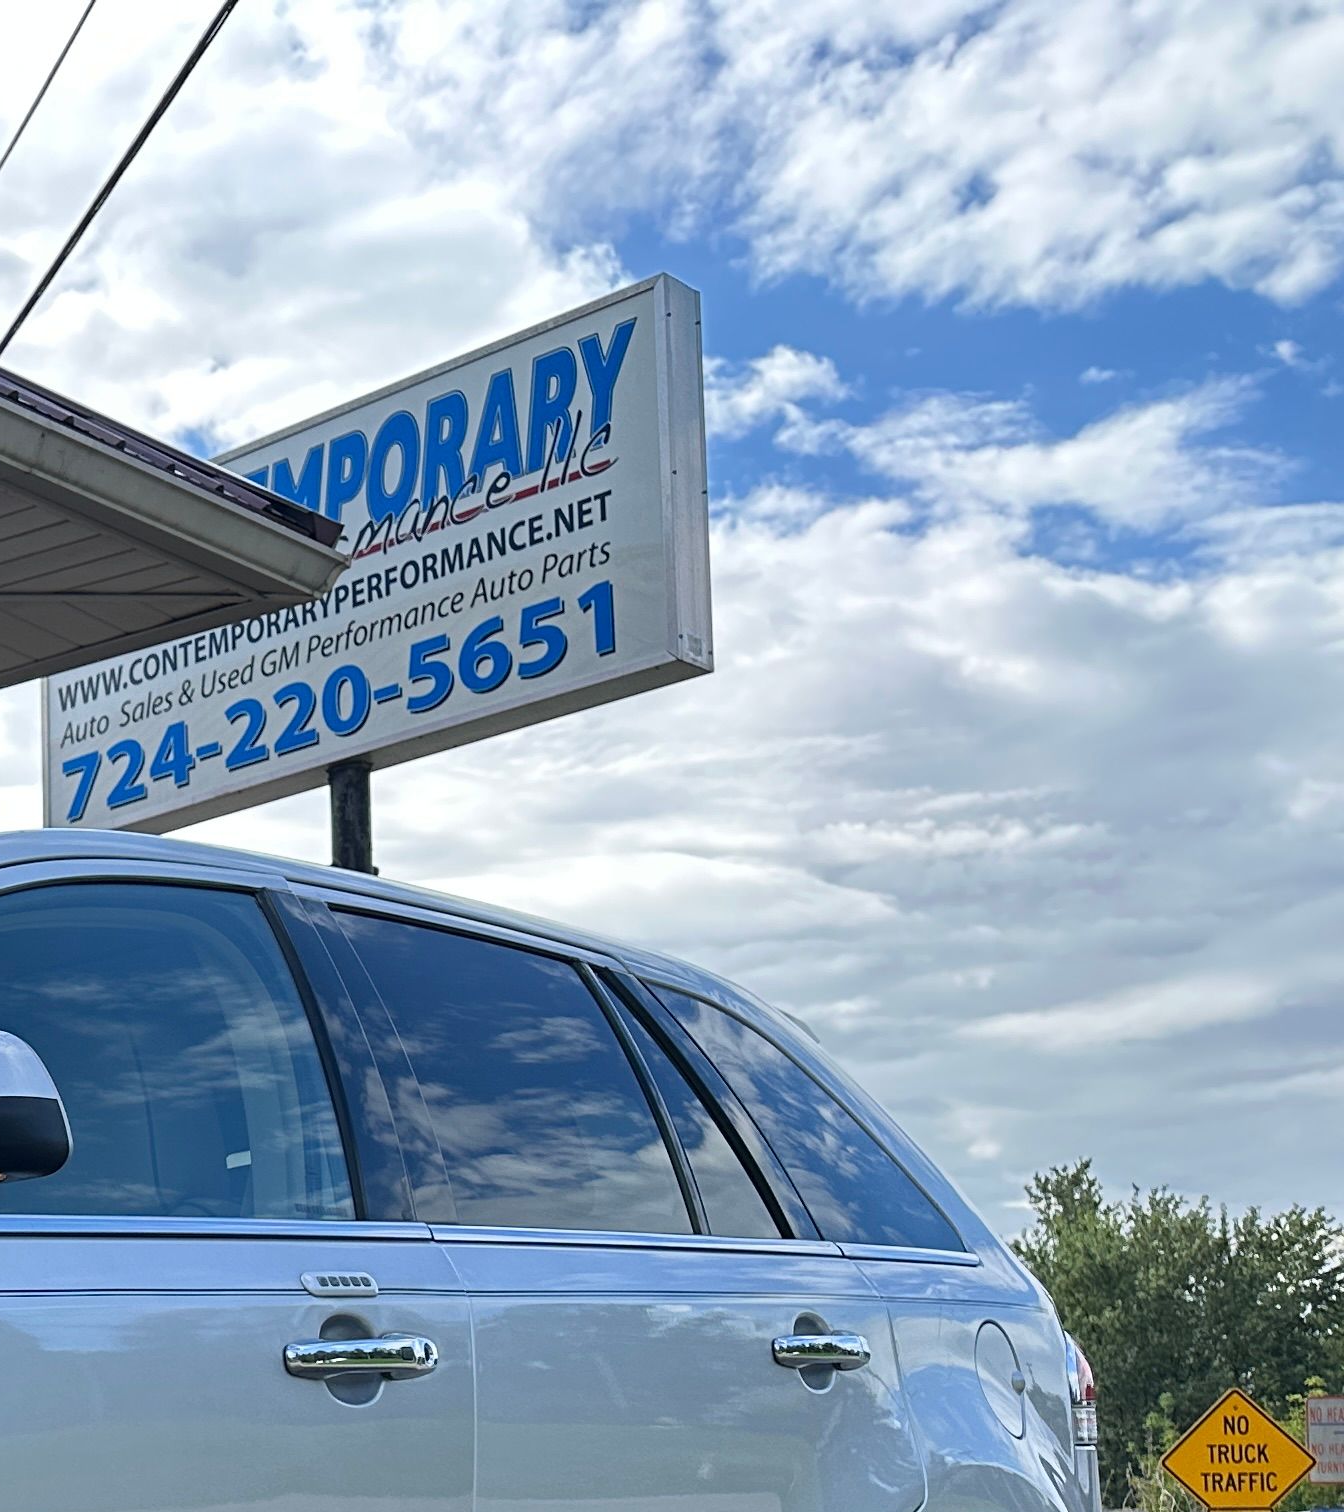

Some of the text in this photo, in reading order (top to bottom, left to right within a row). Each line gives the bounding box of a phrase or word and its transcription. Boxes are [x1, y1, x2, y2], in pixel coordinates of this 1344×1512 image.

[341, 471, 517, 560] mance
[57, 489, 613, 712] WWW.CONTEMPORARYPERFORMANCE.NET
[60, 540, 612, 749] Auto Sales & Used GM Performance Auto Parts
[62, 579, 617, 824] 724-220-5651
[1223, 1414, 1250, 1436] NO
[1310, 1406, 1344, 1422] NO HEA
[1206, 1443, 1270, 1464] TRUCK
[1200, 1471, 1279, 1493] TRAFFIC
